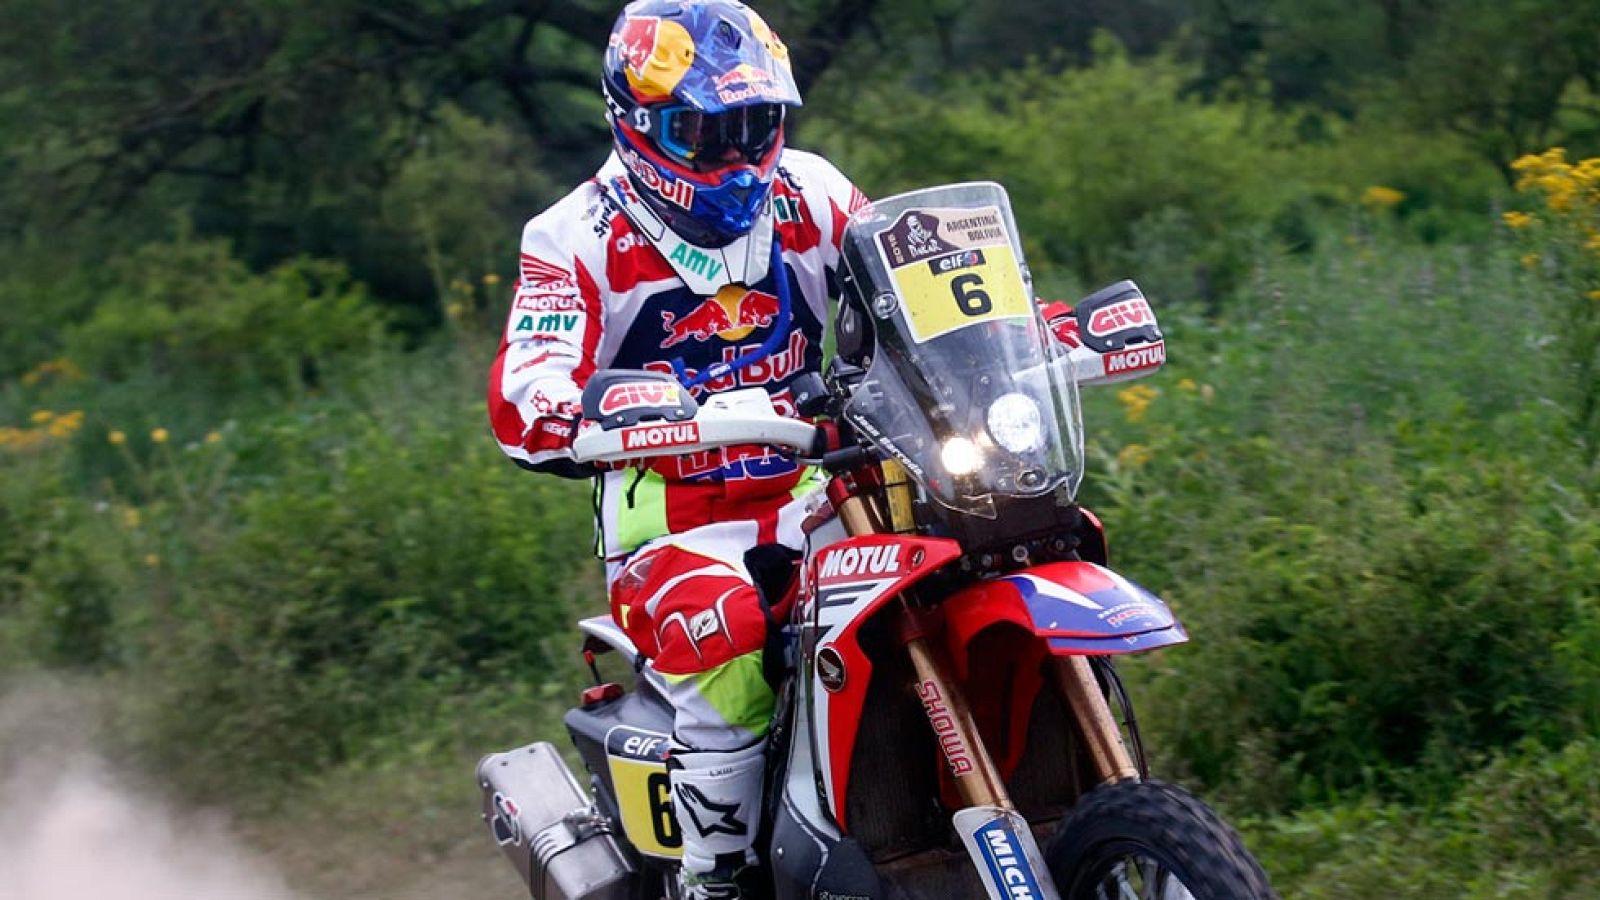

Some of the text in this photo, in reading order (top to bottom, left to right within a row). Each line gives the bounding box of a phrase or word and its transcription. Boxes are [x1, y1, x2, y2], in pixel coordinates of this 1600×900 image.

[945, 213, 999, 234] ARGENTINA
[967, 227, 1003, 242] BOLIVIA
[939, 254, 965, 271] elf
[949, 272, 993, 317] 6
[738, 329, 809, 386] Bull
[1108, 345, 1165, 372] MOTUL
[627, 424, 697, 448] MOTUL
[819, 543, 902, 578] MOTUL
[914, 679, 974, 777] SHOWA
[623, 736, 663, 756] elf
[647, 771, 684, 848] 6
